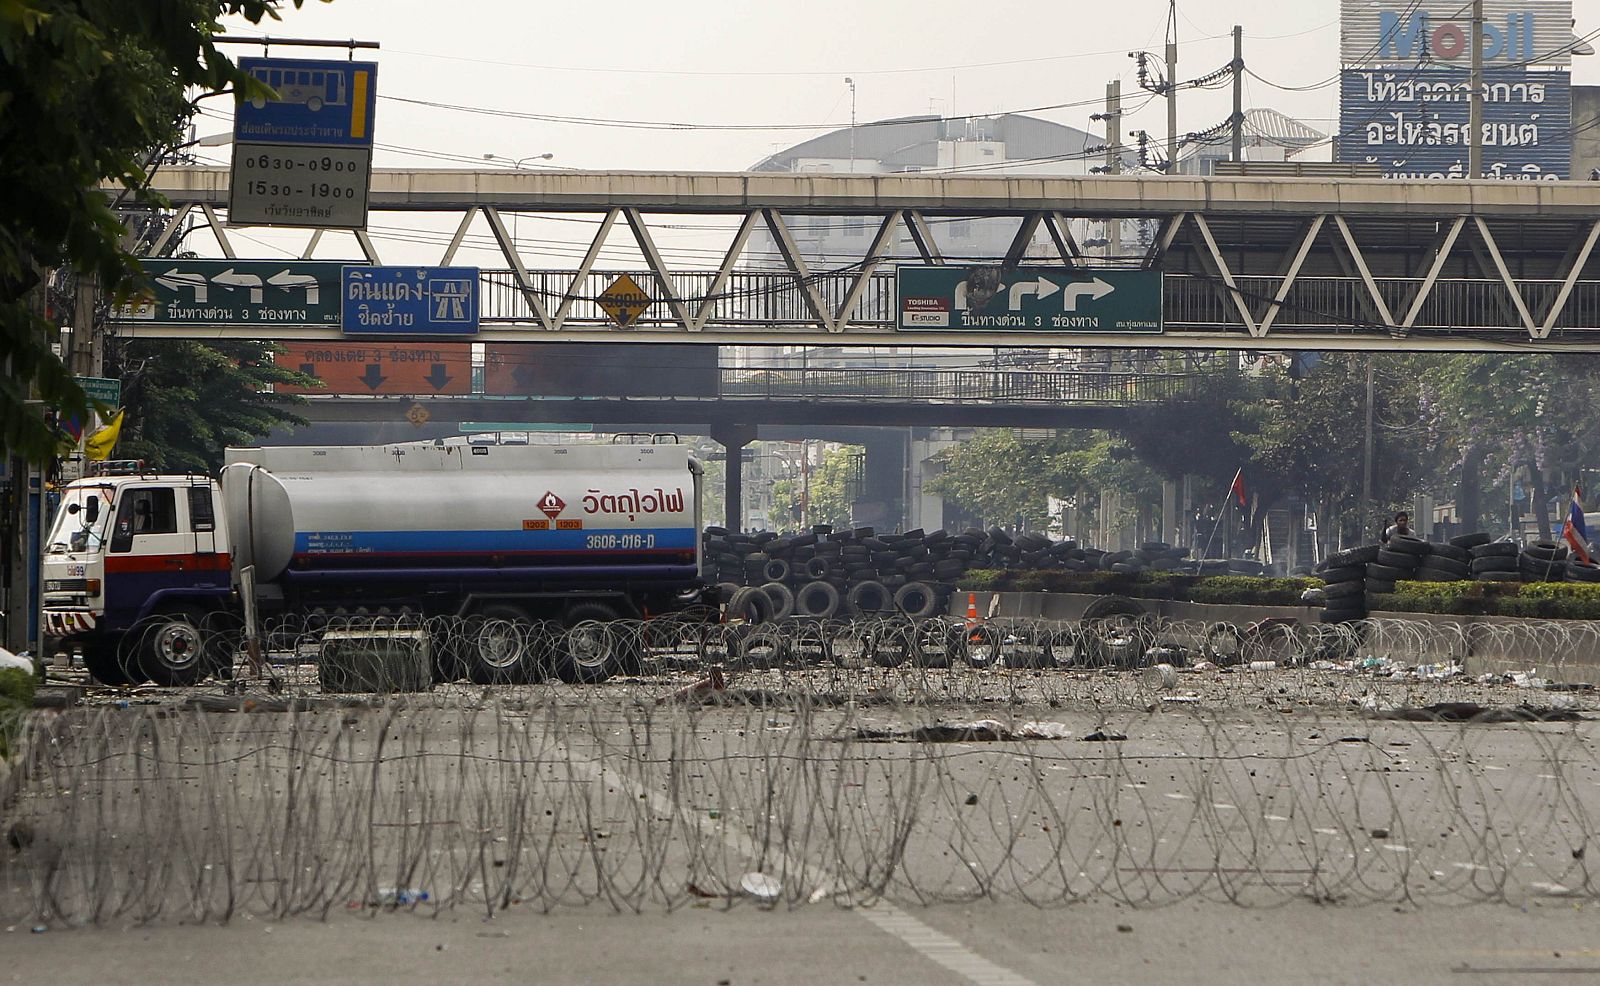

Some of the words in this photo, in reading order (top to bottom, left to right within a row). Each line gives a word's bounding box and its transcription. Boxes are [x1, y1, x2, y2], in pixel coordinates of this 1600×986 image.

[1379, 10, 1535, 60] Mobil
[1366, 112, 1539, 147] อะไหล่รถยนต์
[246, 155, 356, 172] 0630-0900
[168, 299, 233, 319] ขึ้นทางด่วน
[242, 309, 249, 319] 3
[258, 307, 306, 320] ช่องทาง
[358, 303, 414, 326] ชิดซ้าย
[961, 307, 1026, 327] ขึ้นทางด่วน
[1034, 315, 1042, 327] 3
[1051, 314, 1098, 328] ช่องทาง
[373, 351, 381, 362] 3
[389, 345, 441, 363] ช่องทาง
[582, 488, 684, 521] วัตถุไวไฟ
[526, 521, 545, 529] 1202
